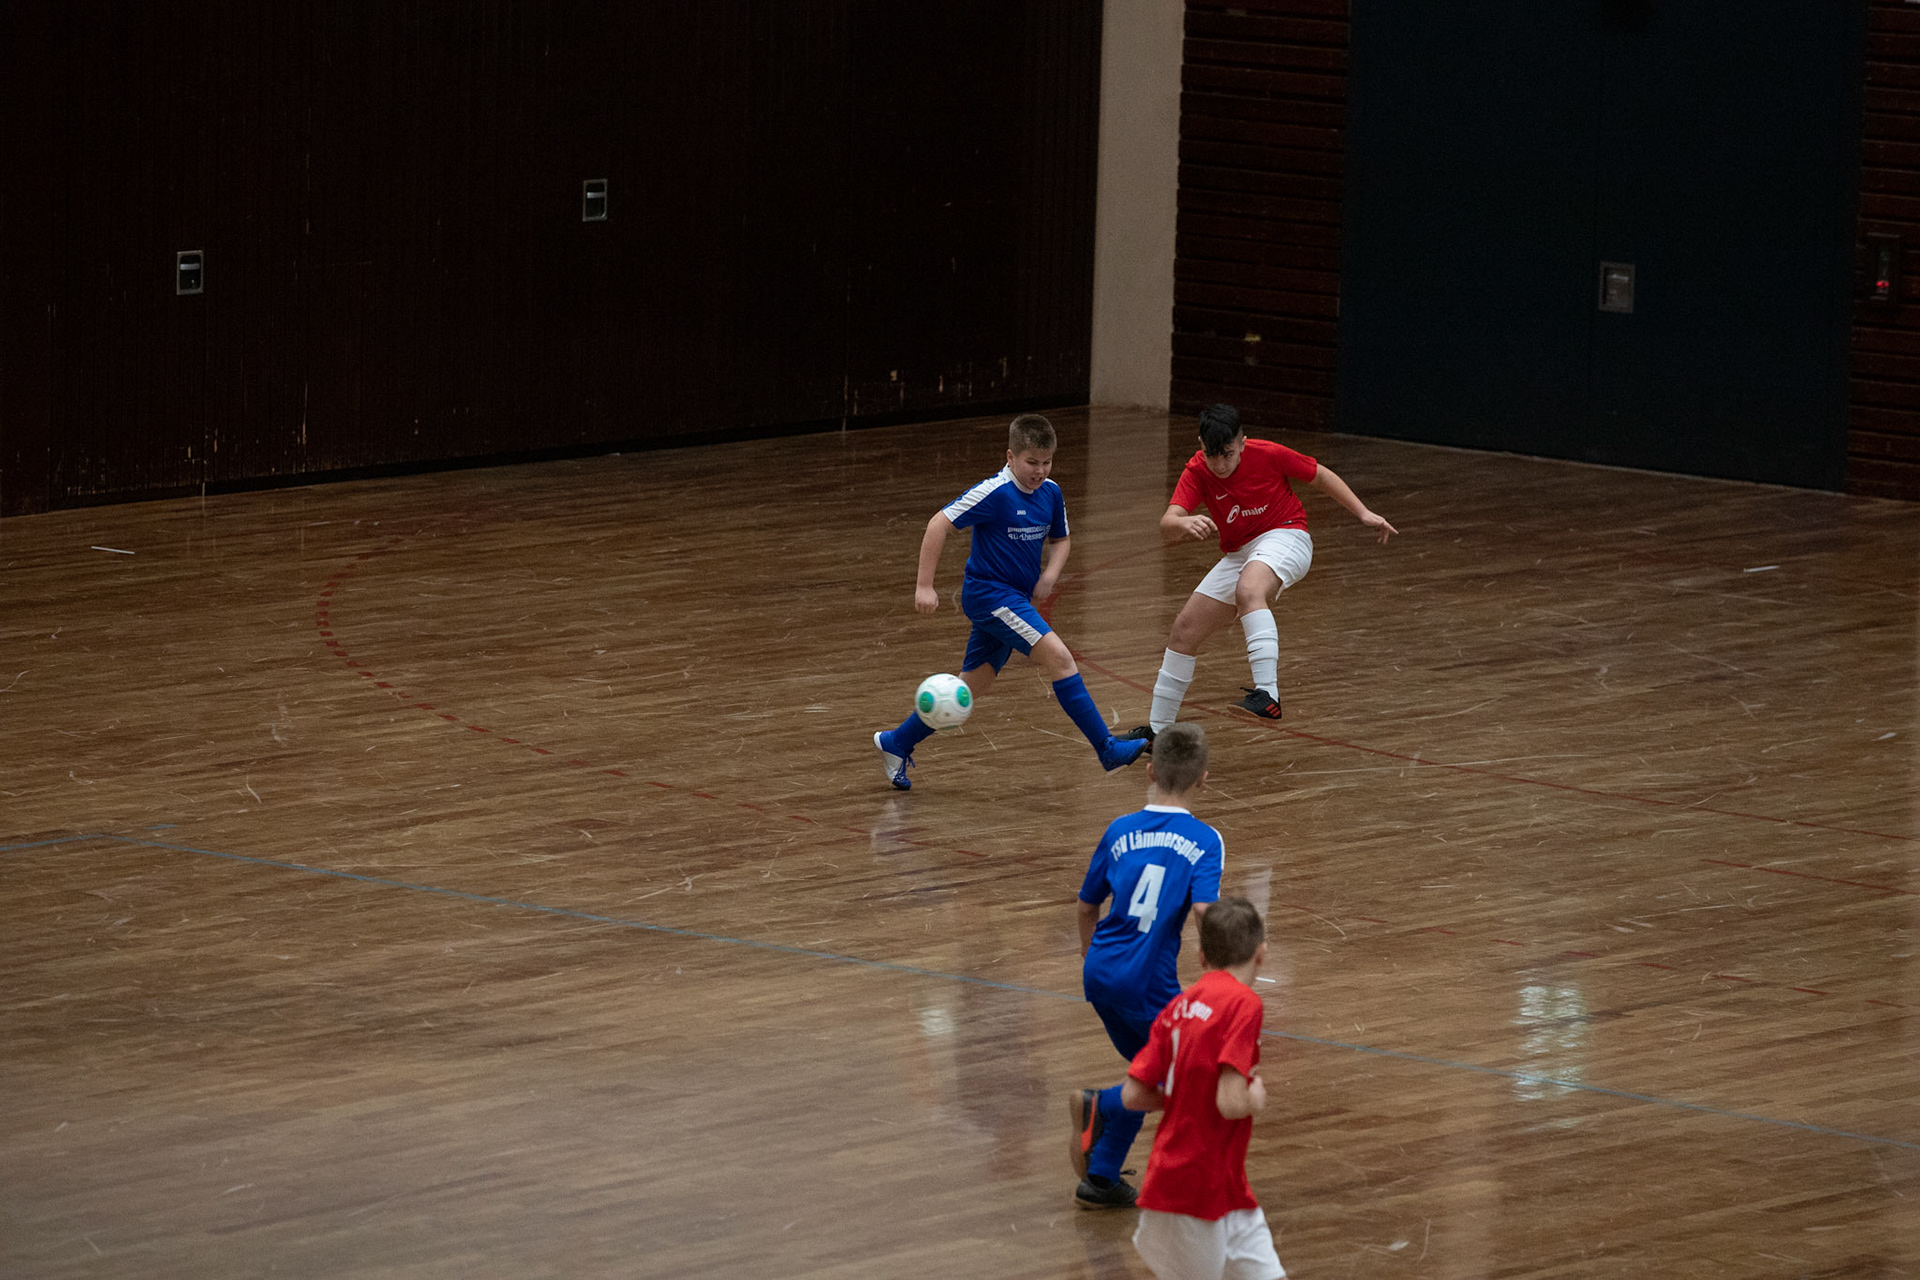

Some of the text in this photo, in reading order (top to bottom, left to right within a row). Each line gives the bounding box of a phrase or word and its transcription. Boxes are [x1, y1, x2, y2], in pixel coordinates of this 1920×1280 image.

[1110, 829, 1206, 866] TSV Lämmerspiel
[1127, 863, 1167, 934] 4
